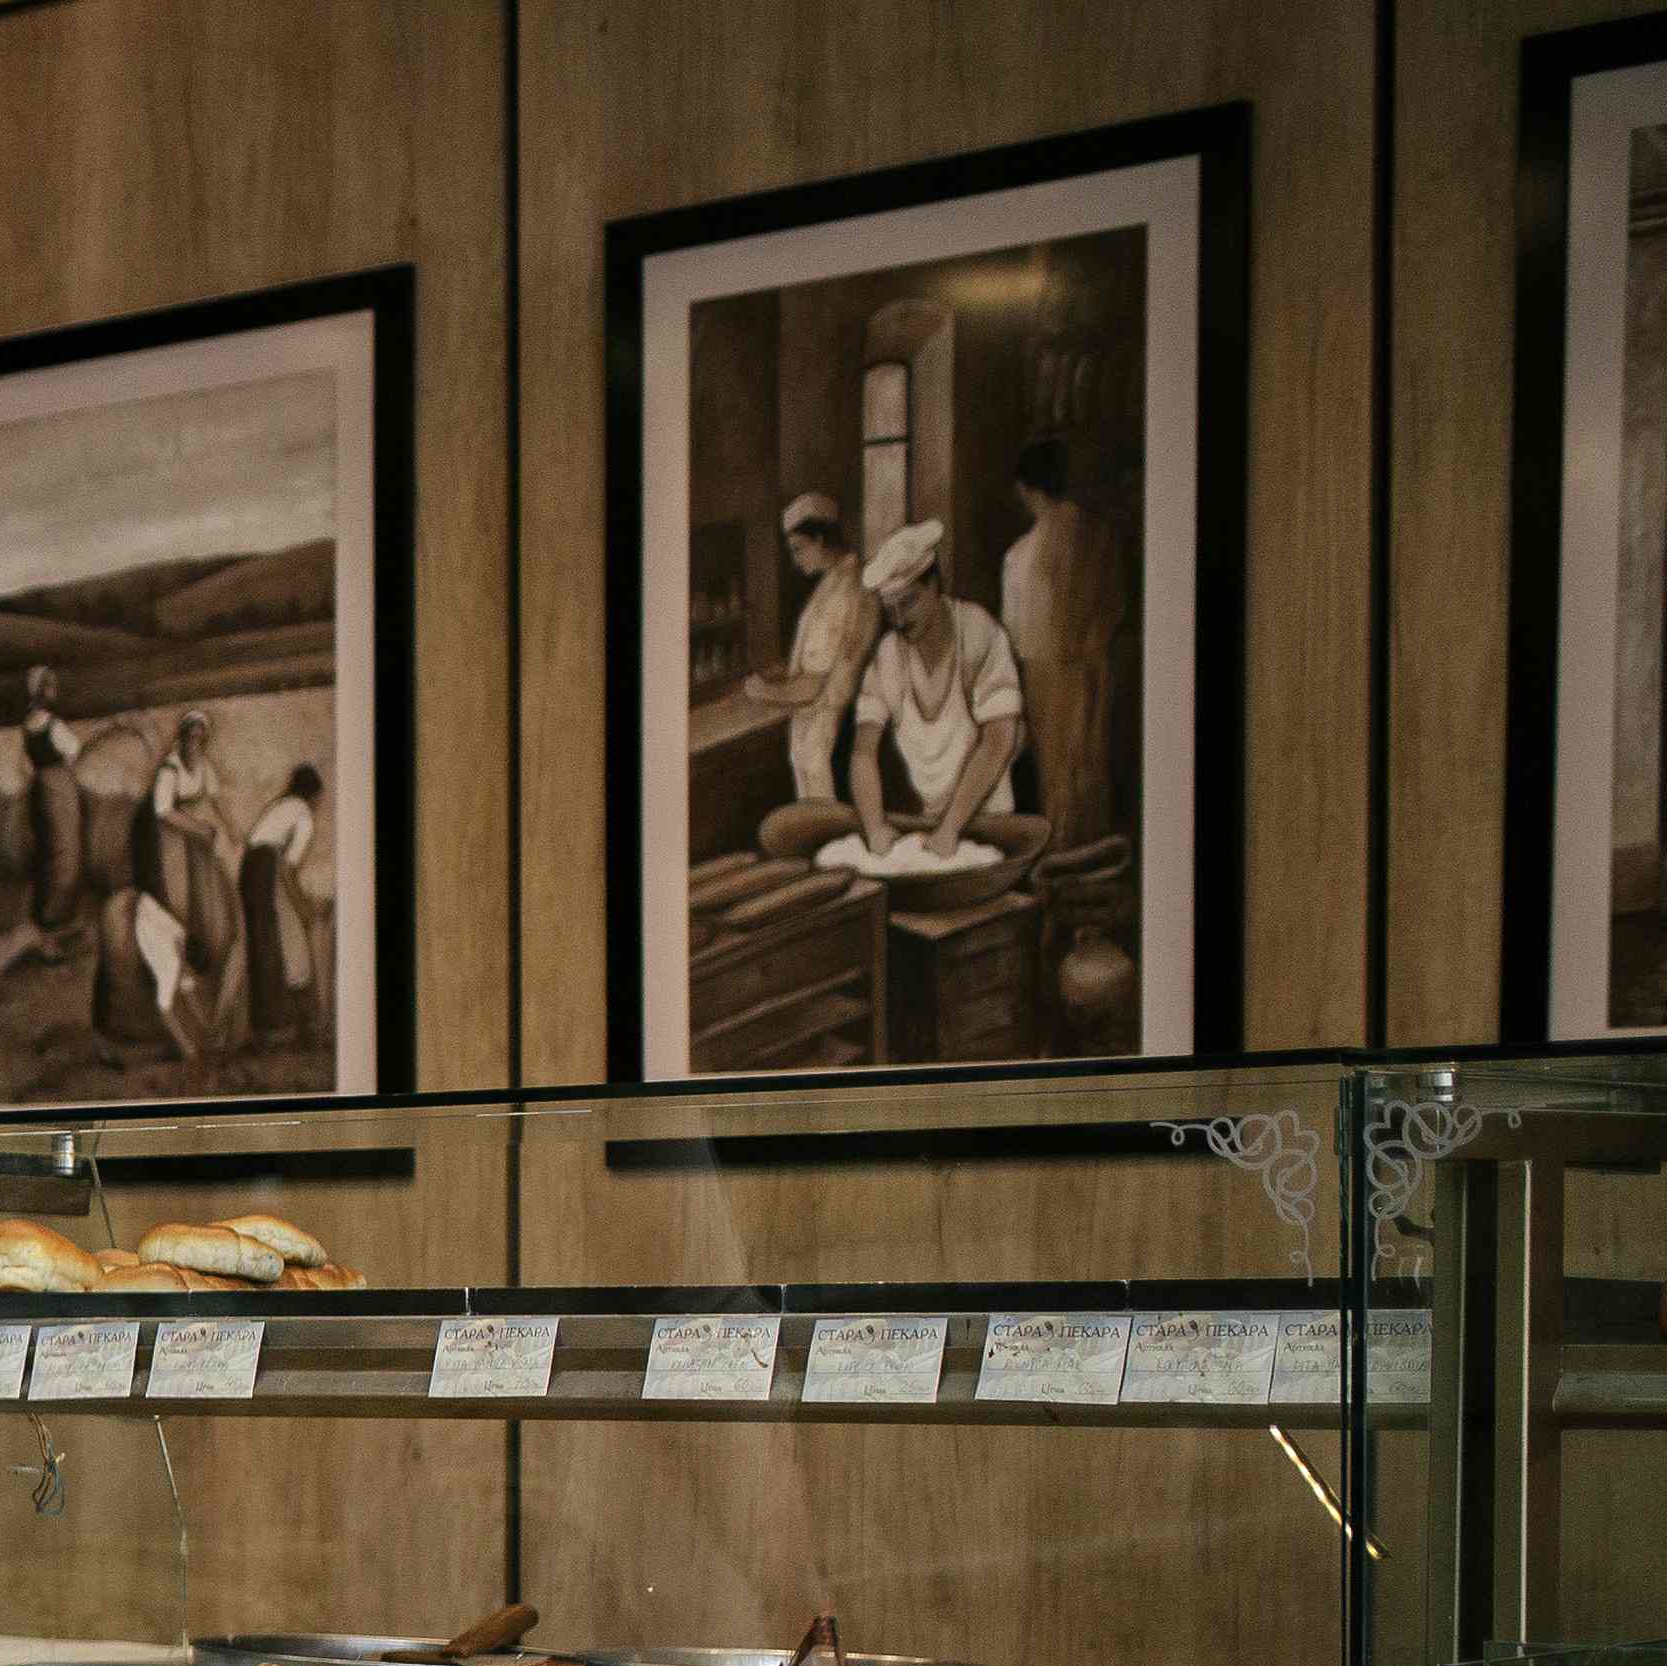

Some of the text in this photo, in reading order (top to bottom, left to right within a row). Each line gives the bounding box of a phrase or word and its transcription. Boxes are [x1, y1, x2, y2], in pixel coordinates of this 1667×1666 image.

[161, 1329, 256, 1342] СТАРА ПЕКАРА
[444, 1326, 550, 1340] СТАРА ПЕКАРА
[658, 1327, 771, 1339] СТАРА ПЕКАРА
[818, 1328, 938, 1341] СТАРА ПЕКАРА
[994, 1324, 1120, 1339] СТАРА ПЕКАРА
[1136, 1324, 1269, 1337] СТАРА ПЕКАРА
[1285, 1324, 1337, 1337] СТАРА
[41, 1329, 132, 1346] СТАРА ПЕКАРА
